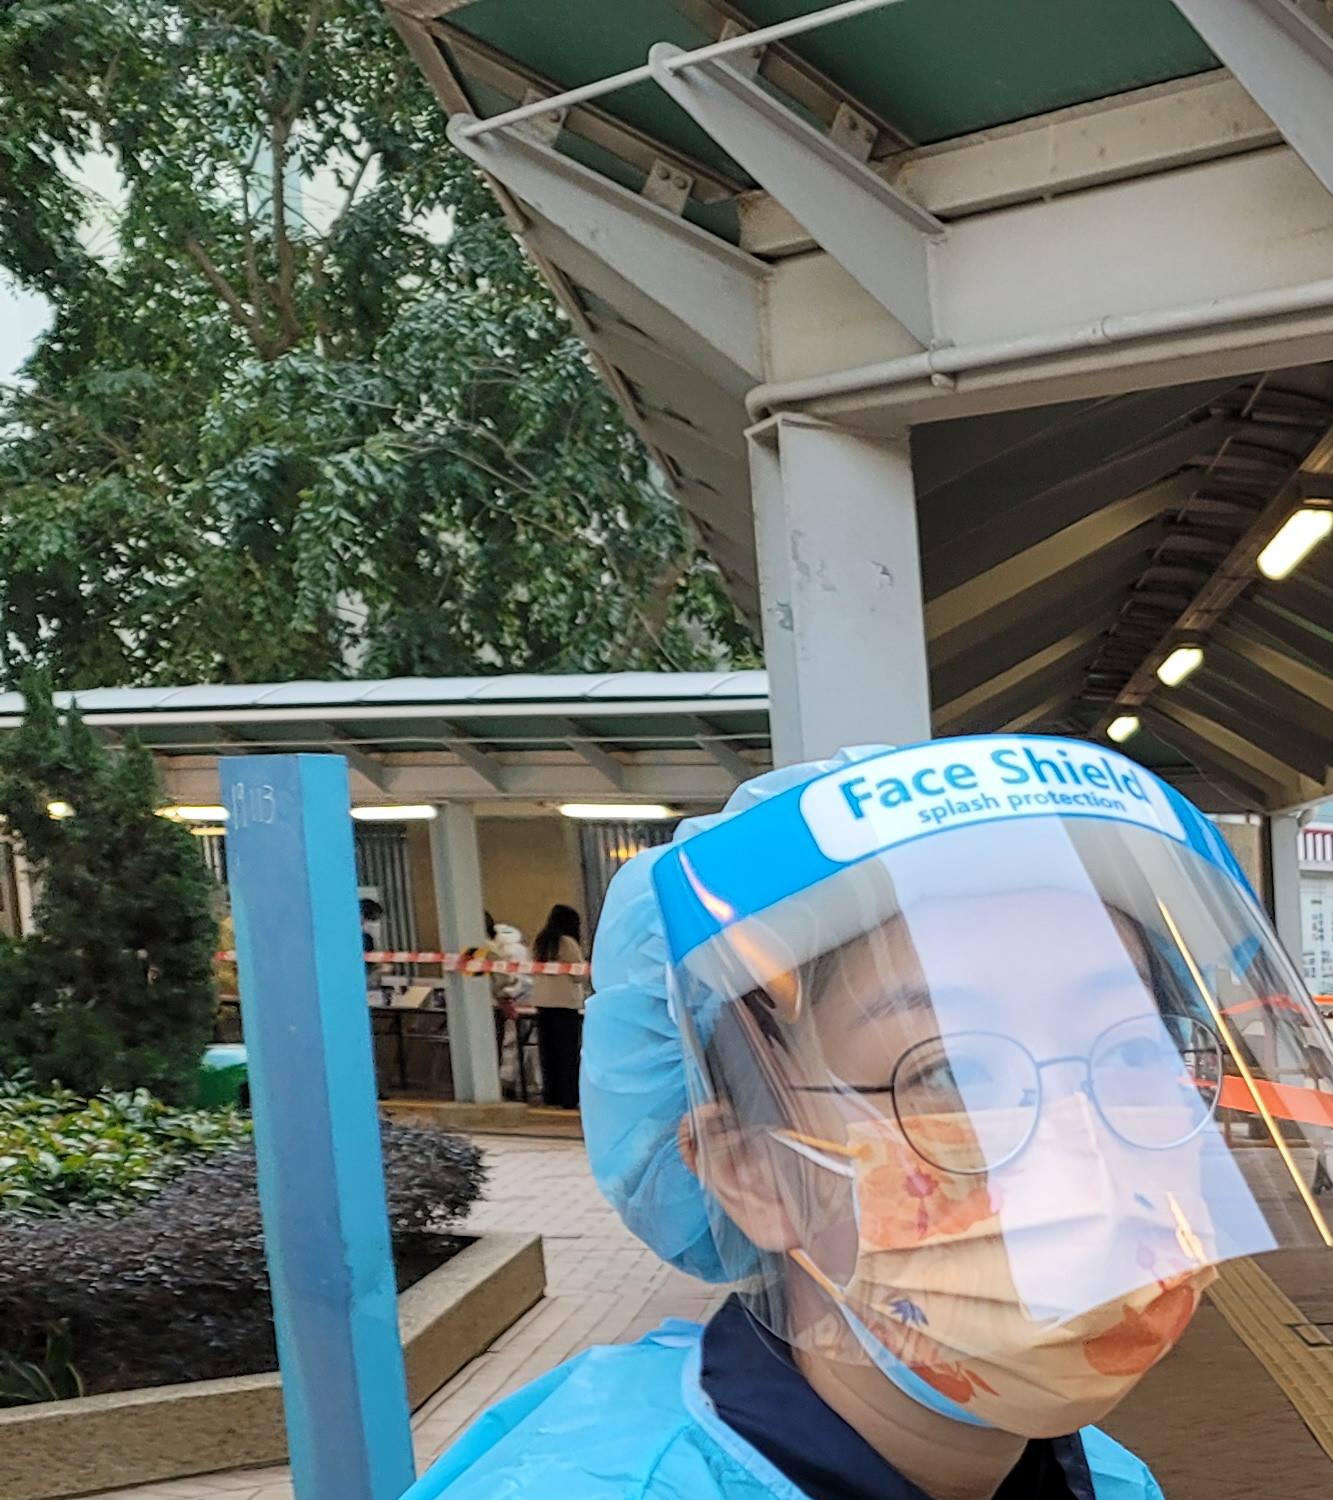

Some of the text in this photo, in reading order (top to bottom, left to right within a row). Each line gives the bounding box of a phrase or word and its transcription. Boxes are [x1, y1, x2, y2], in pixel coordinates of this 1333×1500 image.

[839, 747, 1152, 820] Face Shield
[918, 790, 1126, 824] splash protection
